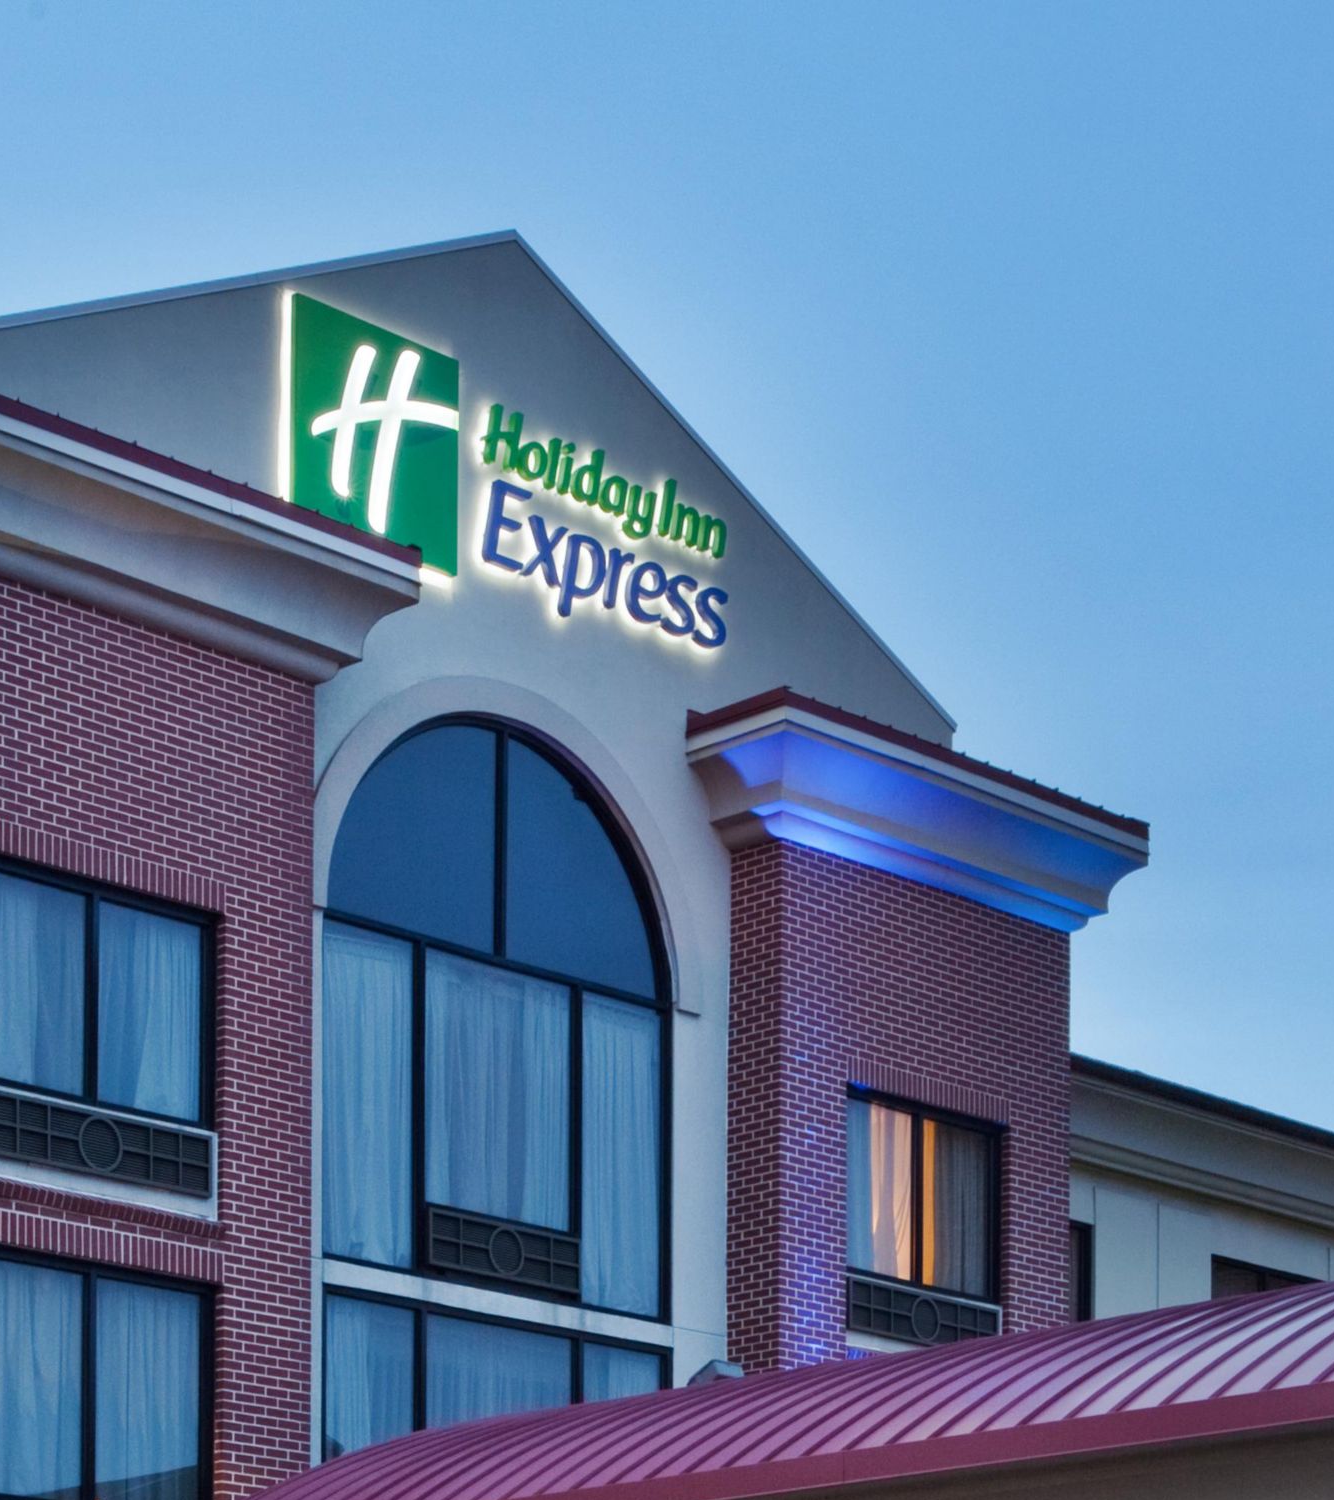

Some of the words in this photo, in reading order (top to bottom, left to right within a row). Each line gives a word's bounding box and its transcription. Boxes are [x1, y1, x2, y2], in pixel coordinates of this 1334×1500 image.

[480, 403, 656, 540] Holiday
[656, 478, 727, 559] Inn
[481, 479, 729, 649] Express
